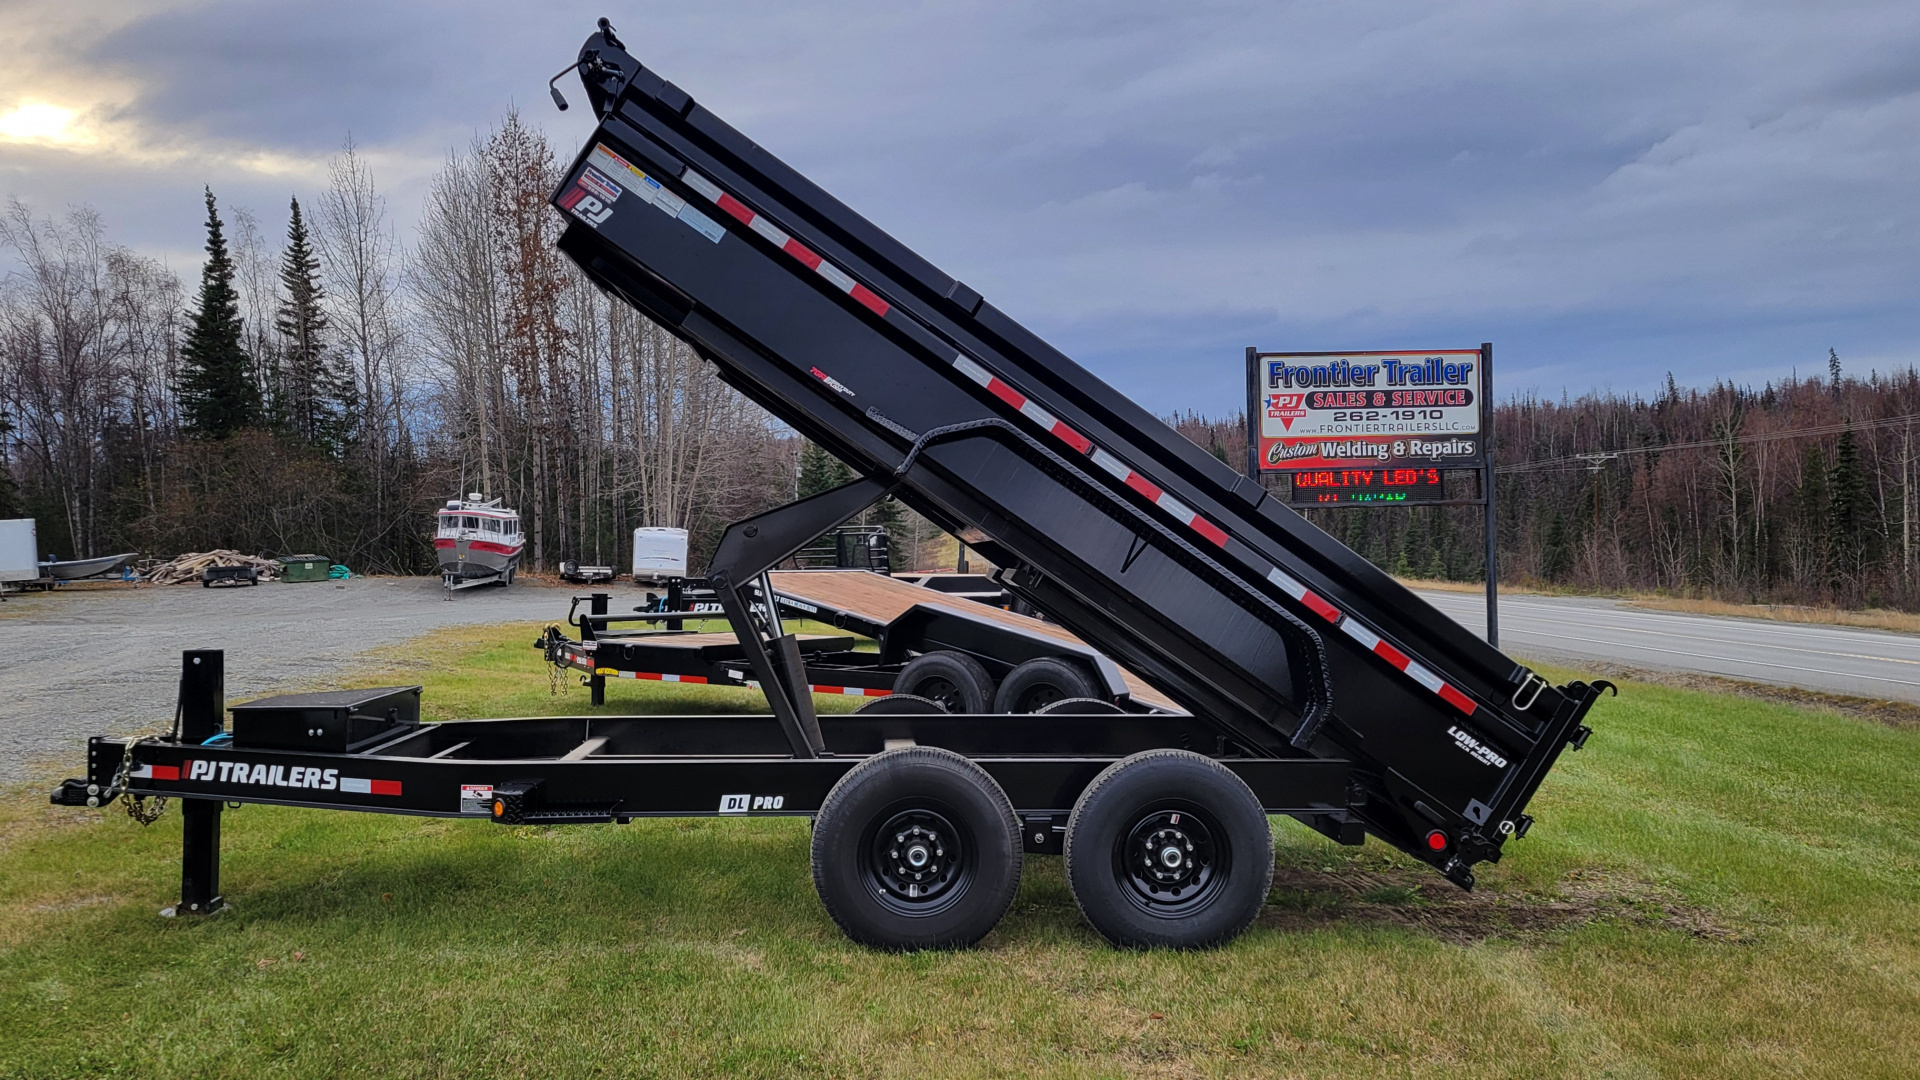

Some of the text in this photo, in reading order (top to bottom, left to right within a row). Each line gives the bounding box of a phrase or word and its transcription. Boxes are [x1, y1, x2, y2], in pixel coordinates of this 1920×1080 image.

[570, 208, 599, 228] TRAILERS
[575, 195, 614, 224] PJ
[1268, 356, 1473, 388] Frontier Trailer
[1278, 396, 1298, 407] PJ
[1314, 390, 1466, 407] SALES & SERVICE
[1333, 410, 1444, 422] 262-1910
[1267, 440, 1474, 463] Custom Welding & Repairs
[1296, 468, 1439, 487] QUALITY LED'S
[1447, 725, 1508, 768] LOW-PRO
[190, 760, 339, 790] PJ TRAILERS
[727, 796, 784, 810] DL PRO
